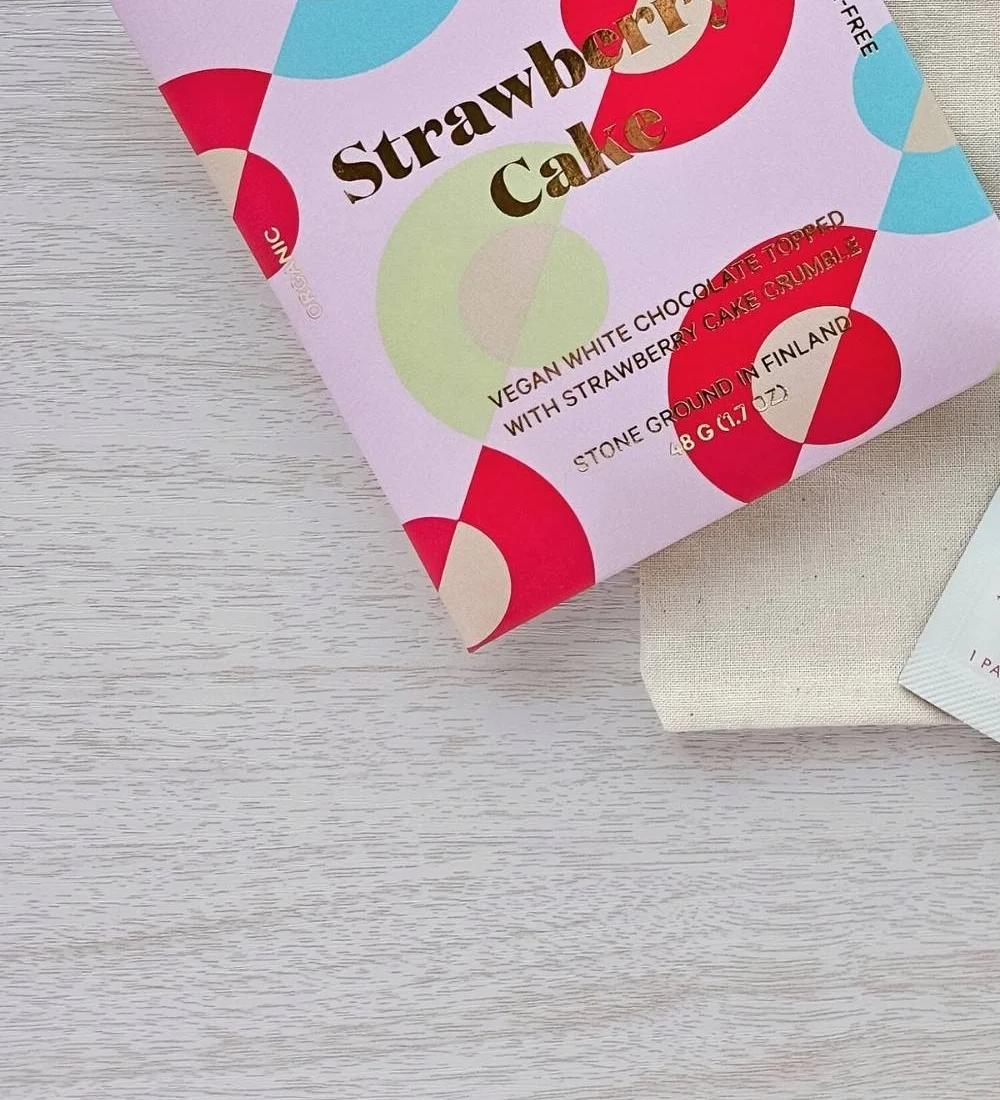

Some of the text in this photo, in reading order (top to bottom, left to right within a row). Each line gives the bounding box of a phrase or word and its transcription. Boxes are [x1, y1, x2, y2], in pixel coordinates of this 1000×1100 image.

[489, 107, 665, 218] Cake
[264, 226, 323, 320] ORGANIC
[485, 205, 848, 413] VEGAN WHITE CHOCOLATE TOPPED
[501, 233, 865, 440] WITH STRAWBERRY CAKE CRUMBLE
[570, 310, 856, 475] STONE GROUND IN FINLAND
[664, 430, 698, 460] 48
[693, 419, 719, 445] G
[712, 401, 754, 436] (1.7
